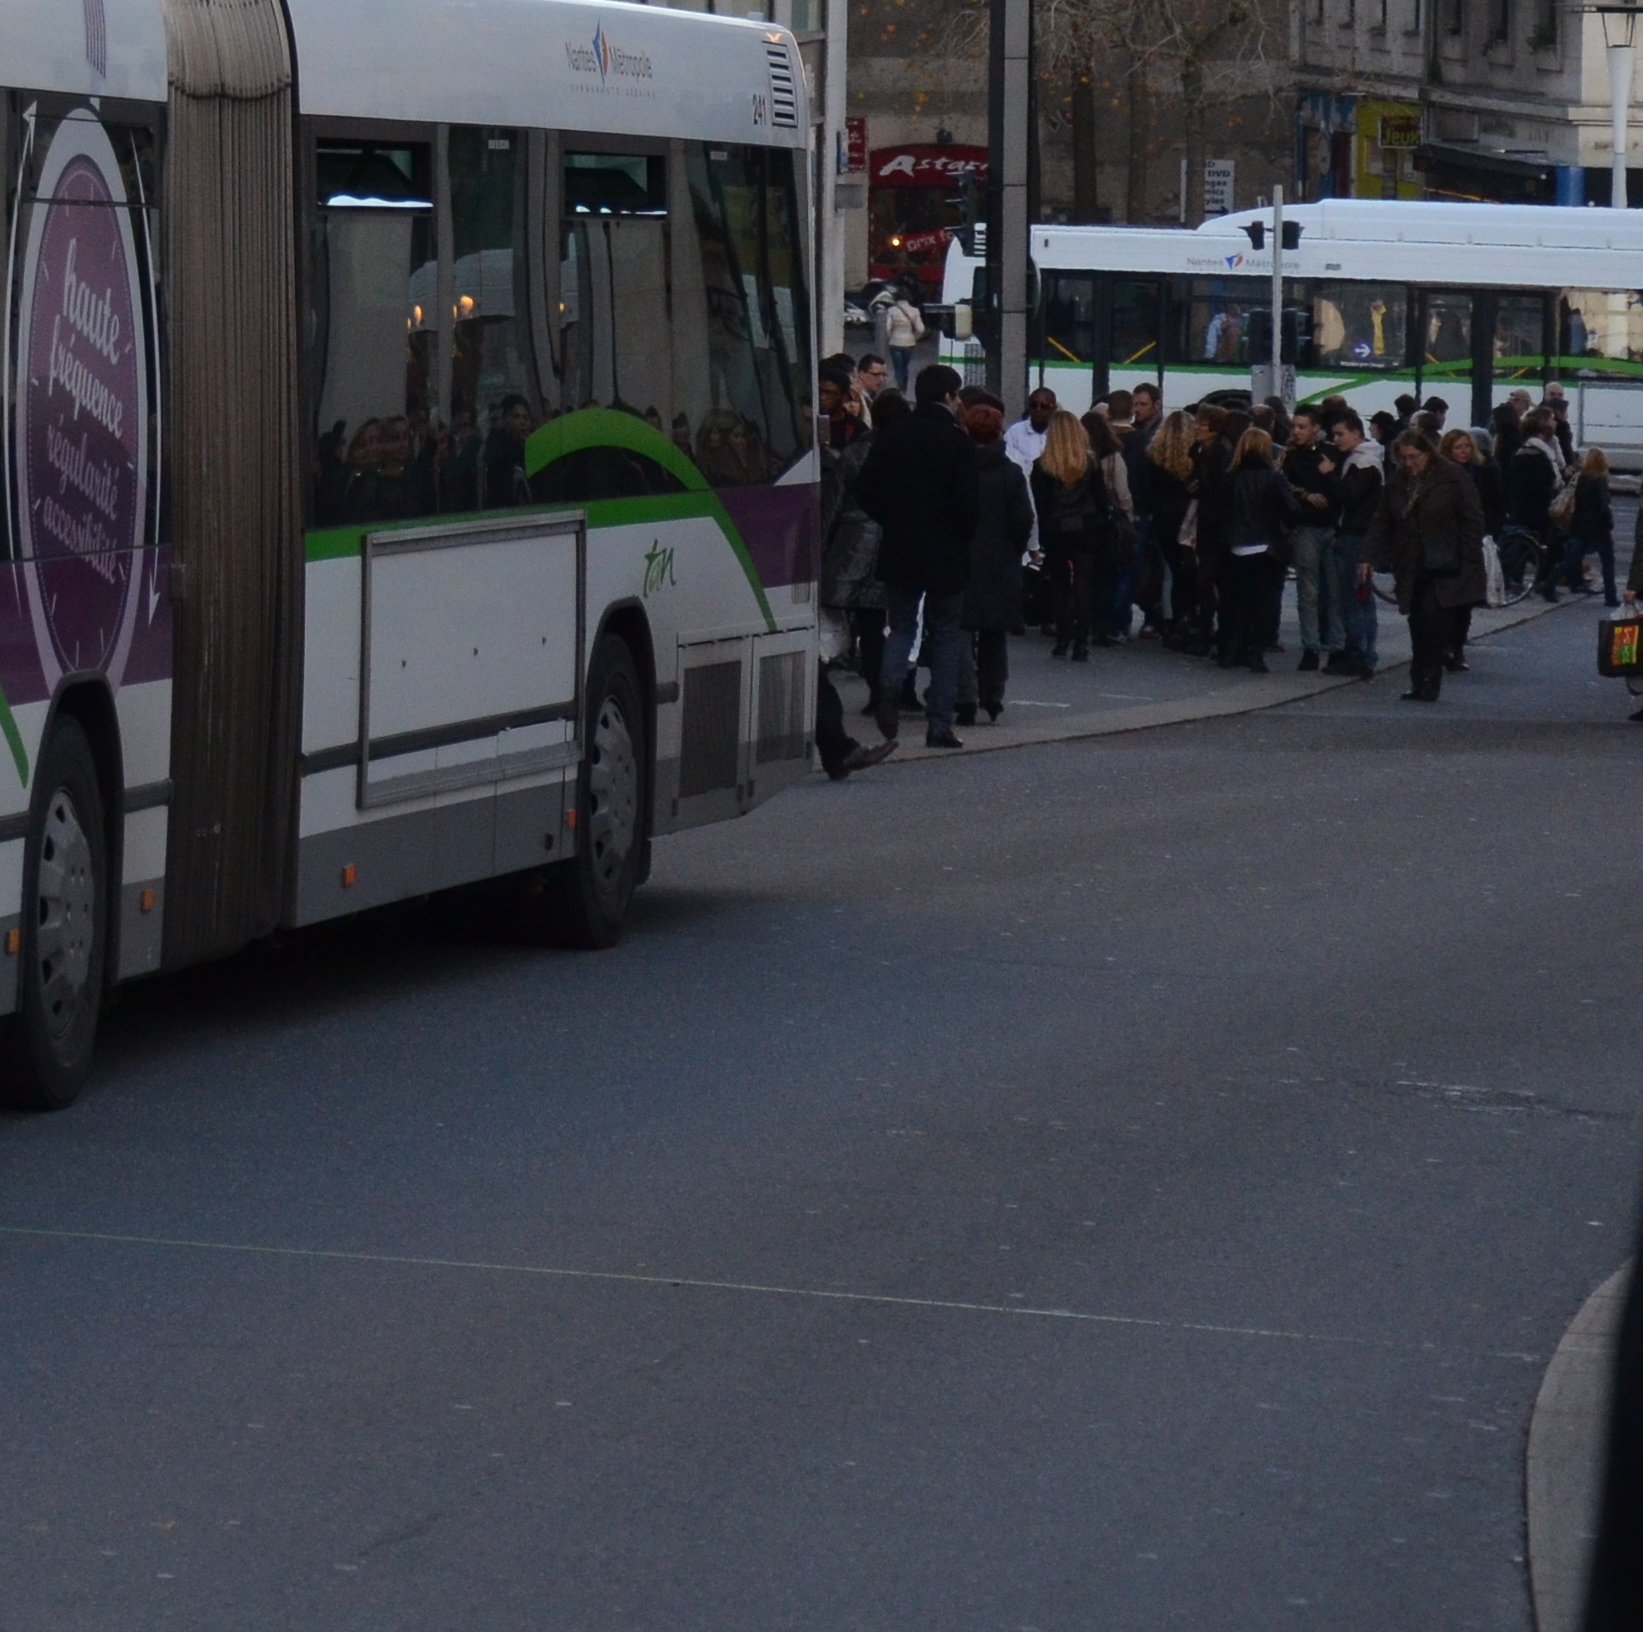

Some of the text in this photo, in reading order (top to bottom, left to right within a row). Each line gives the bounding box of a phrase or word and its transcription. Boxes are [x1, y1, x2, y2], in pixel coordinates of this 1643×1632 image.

[565, 41, 597, 72] Nantes
[752, 93, 767, 126] 241
[63, 237, 121, 366] haute
[1187, 257, 1224, 267] Nantes
[48, 314, 123, 440] fréquence
[46, 413, 120, 521] régularité
[43, 495, 117, 584] accessibilité
